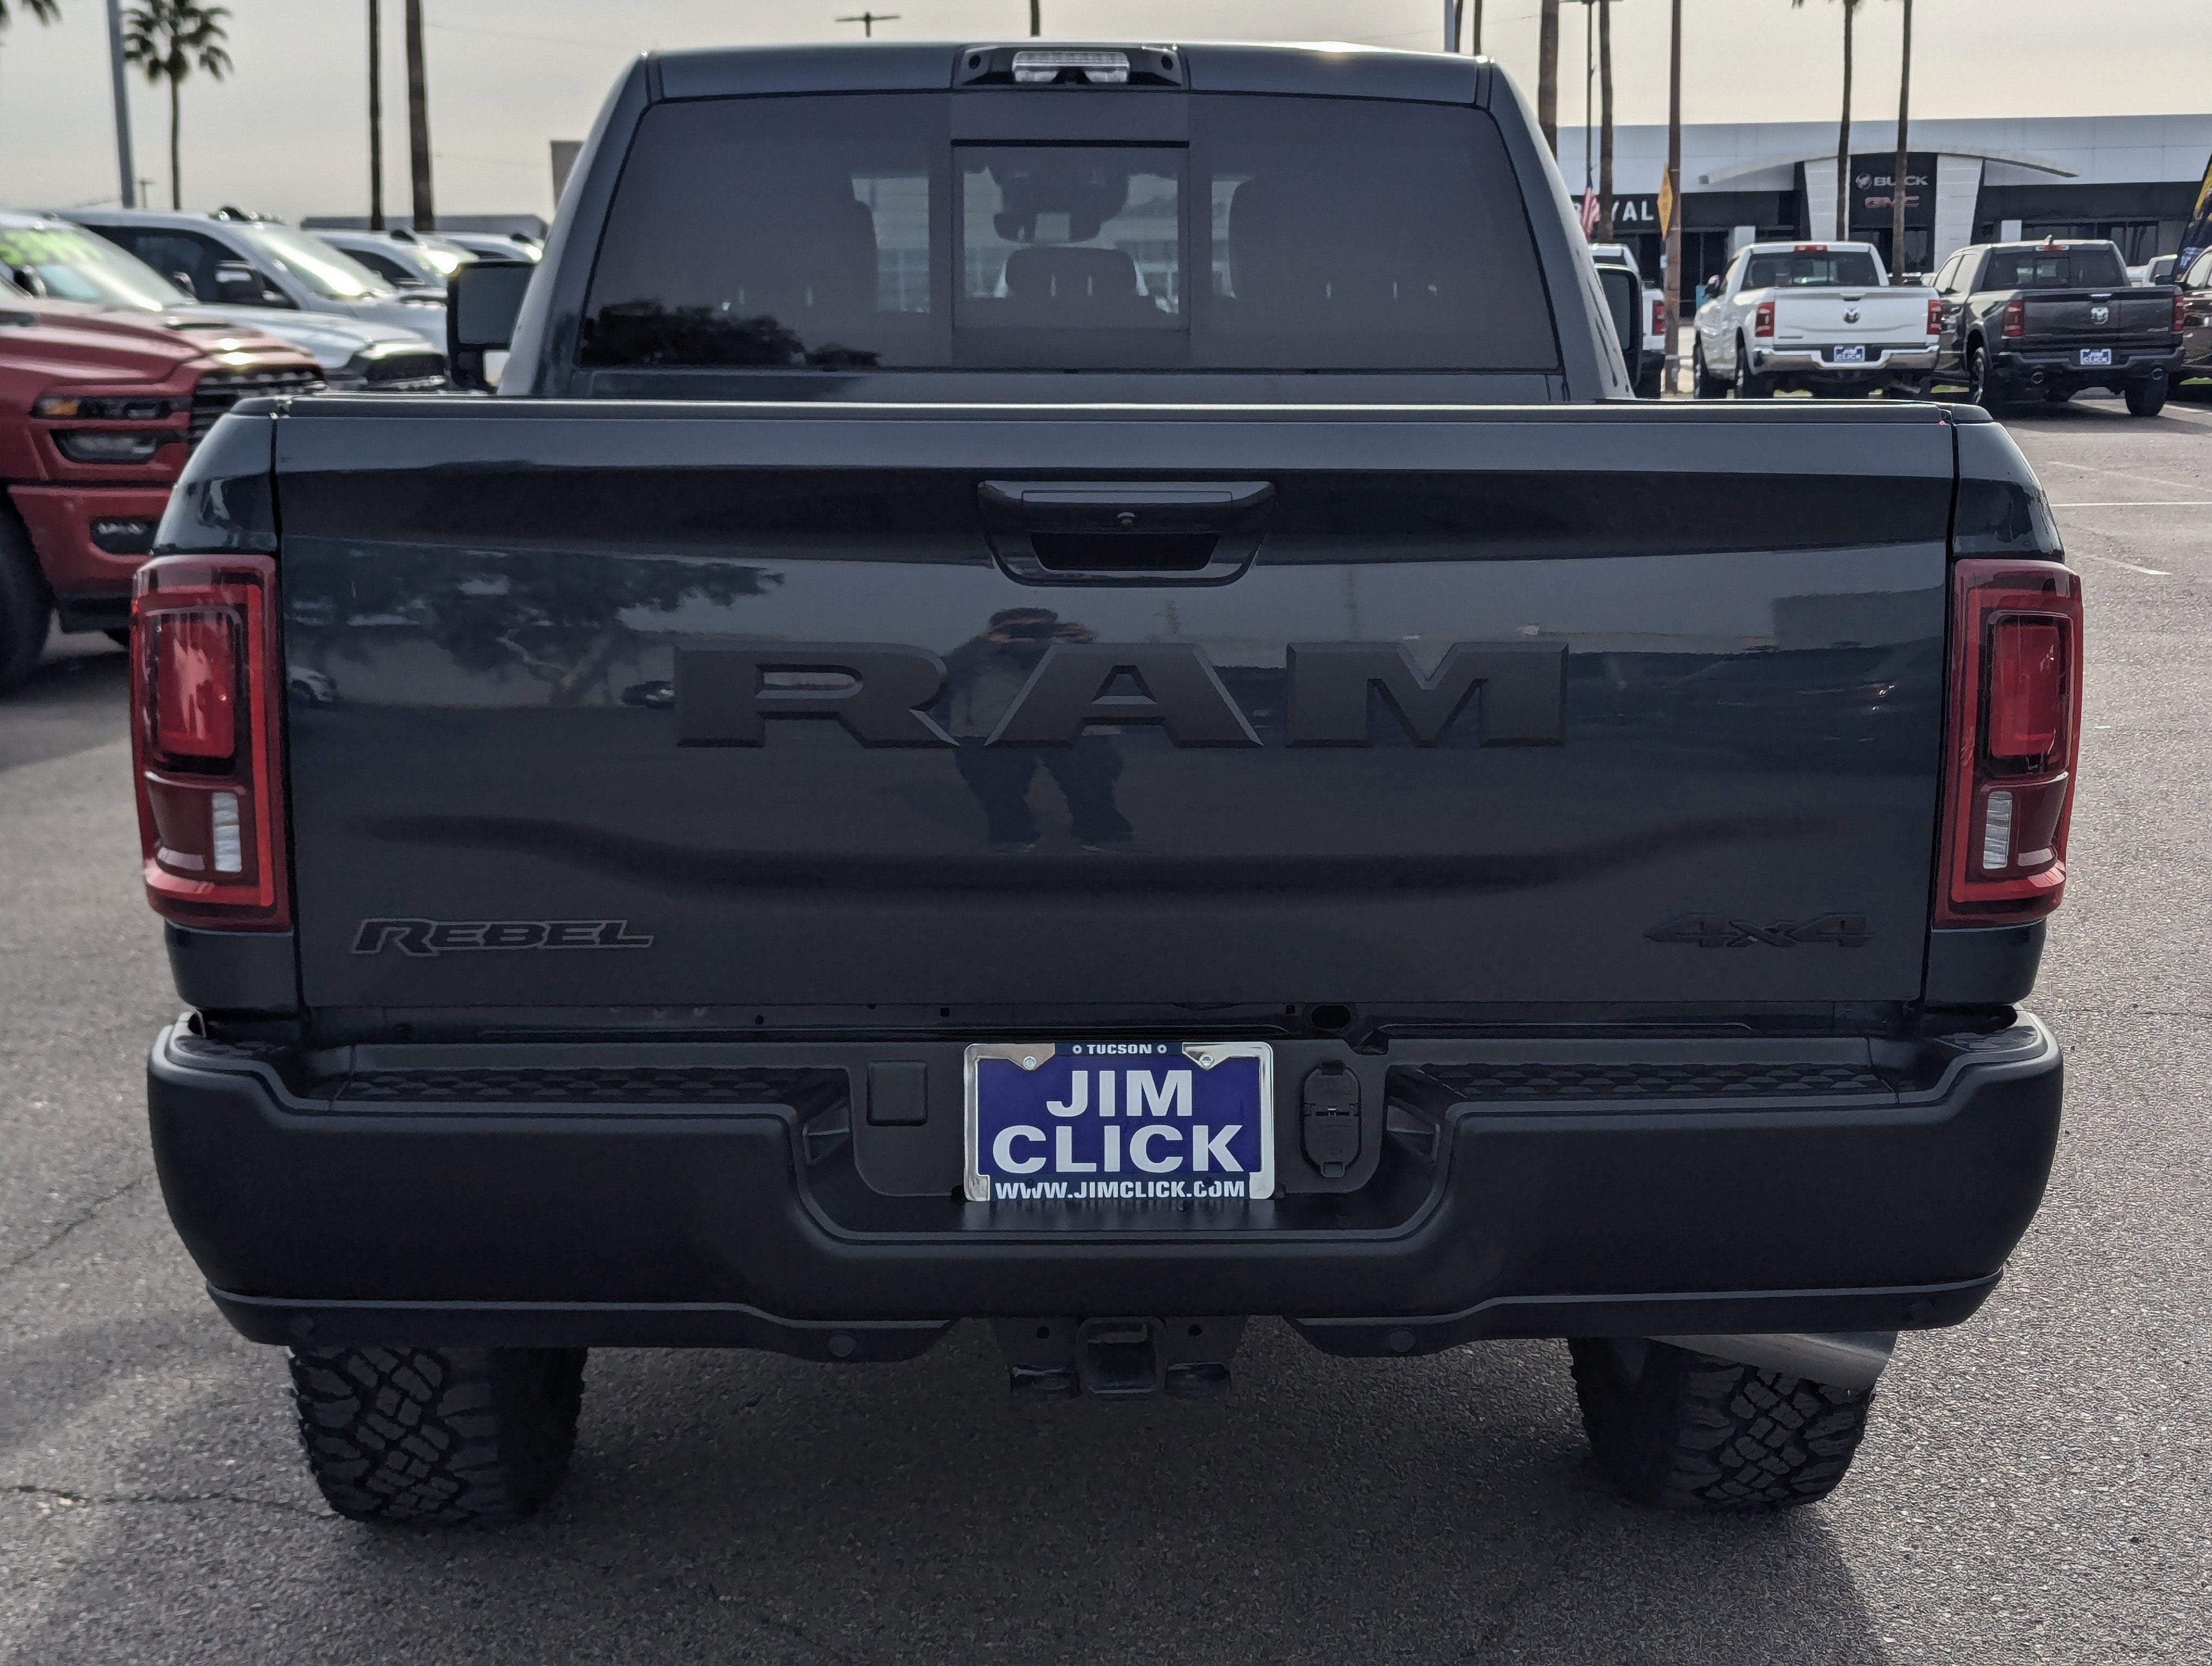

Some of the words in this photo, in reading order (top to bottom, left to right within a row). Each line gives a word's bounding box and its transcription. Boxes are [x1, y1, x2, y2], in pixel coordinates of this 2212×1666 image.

[1874, 176, 1928, 186] BUCK
[675, 642, 1567, 748] RAM
[350, 918, 654, 956] REBEL
[1086, 1044, 1152, 1055] TUCSON
[1046, 1070, 1192, 1117] JIM
[993, 1125, 1244, 1174] CLICK
[995, 1181, 1245, 1199] WWW.JIMCLICK.COM
